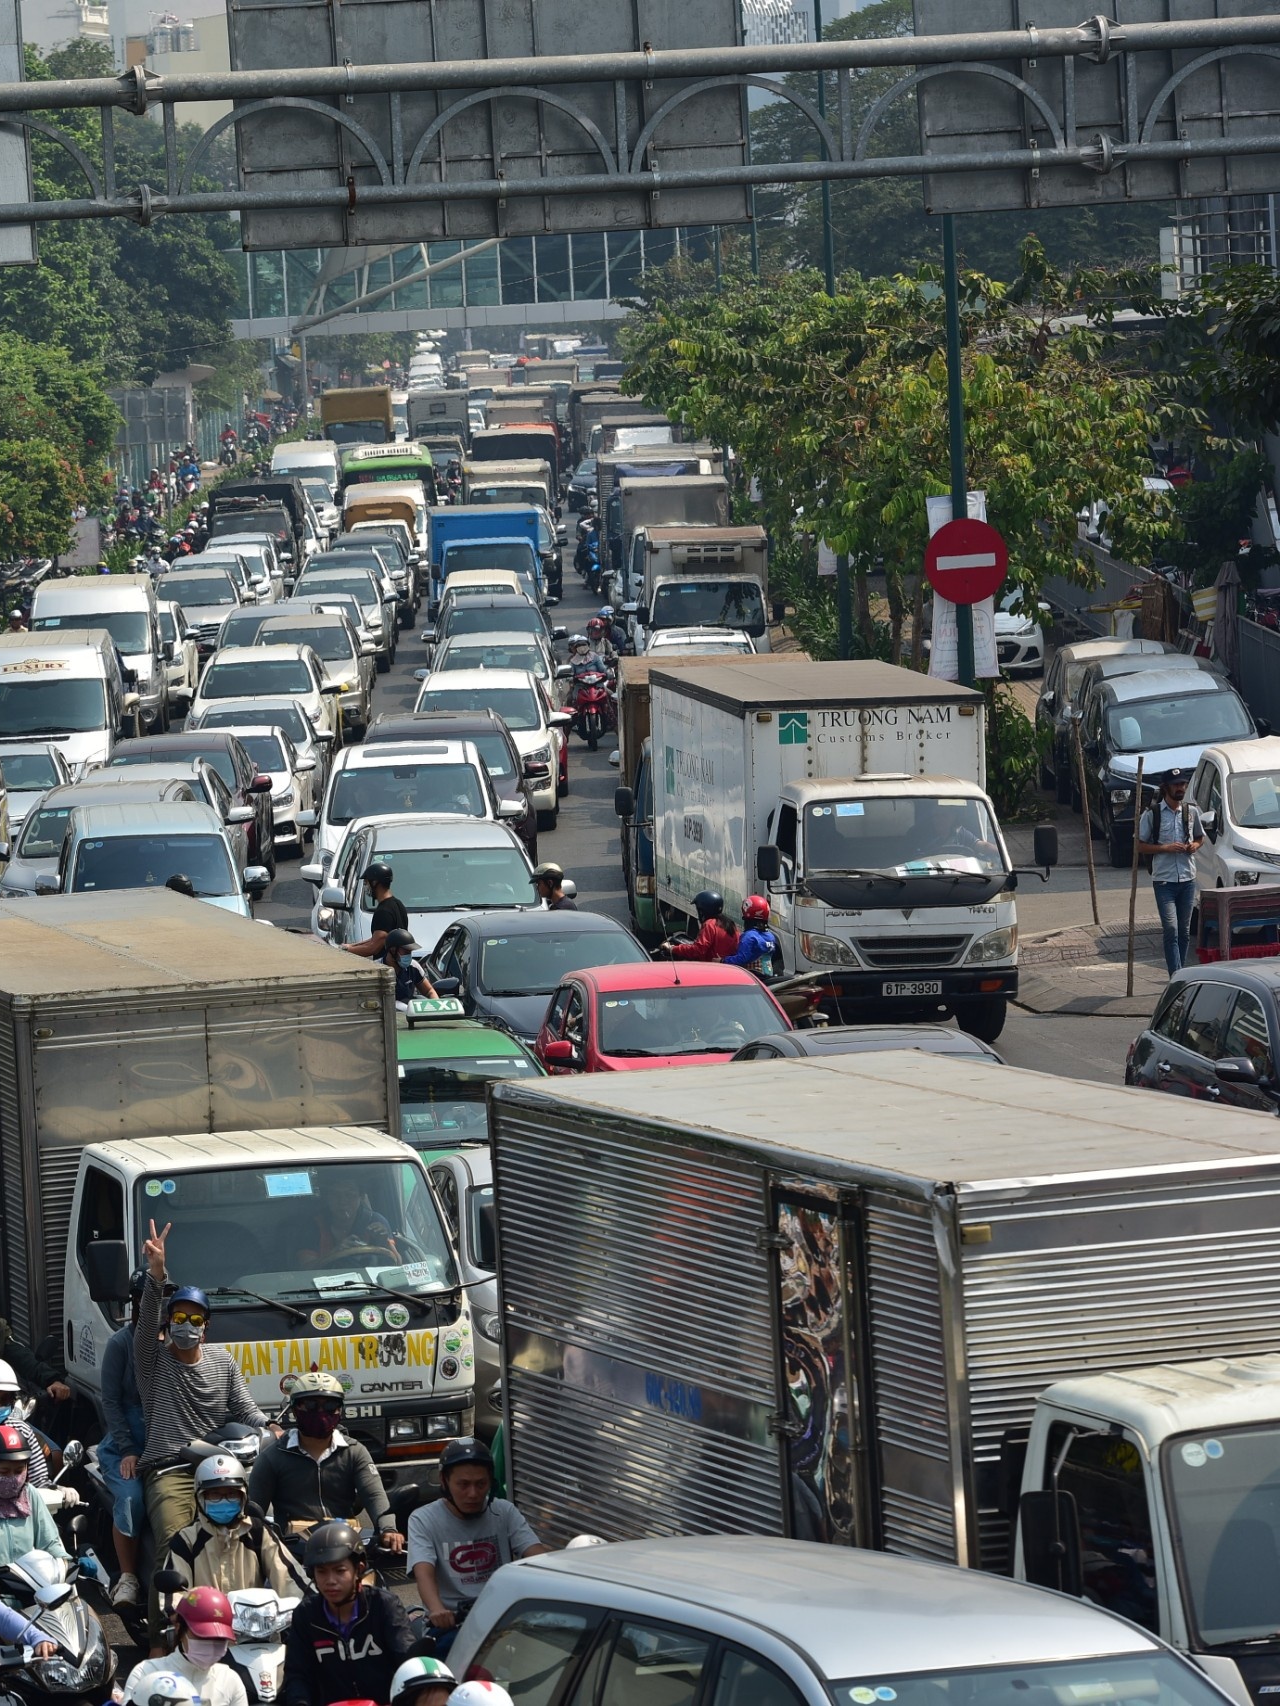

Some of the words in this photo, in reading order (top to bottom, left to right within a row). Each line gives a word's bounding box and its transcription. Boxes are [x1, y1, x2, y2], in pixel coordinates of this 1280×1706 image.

[3, 663, 65, 673] LUXURY
[818, 708, 898, 727] TRUONG
[906, 707, 952, 724] NAM
[817, 730, 885, 744] Customs
[896, 730, 951, 743] Broker
[700, 757, 714, 786] NAM
[885, 982, 939, 995] 61P-3930
[320, 1336, 347, 1371] AN
[360, 1380, 423, 1393] CANTER
[312, 1634, 383, 1663] FILA
